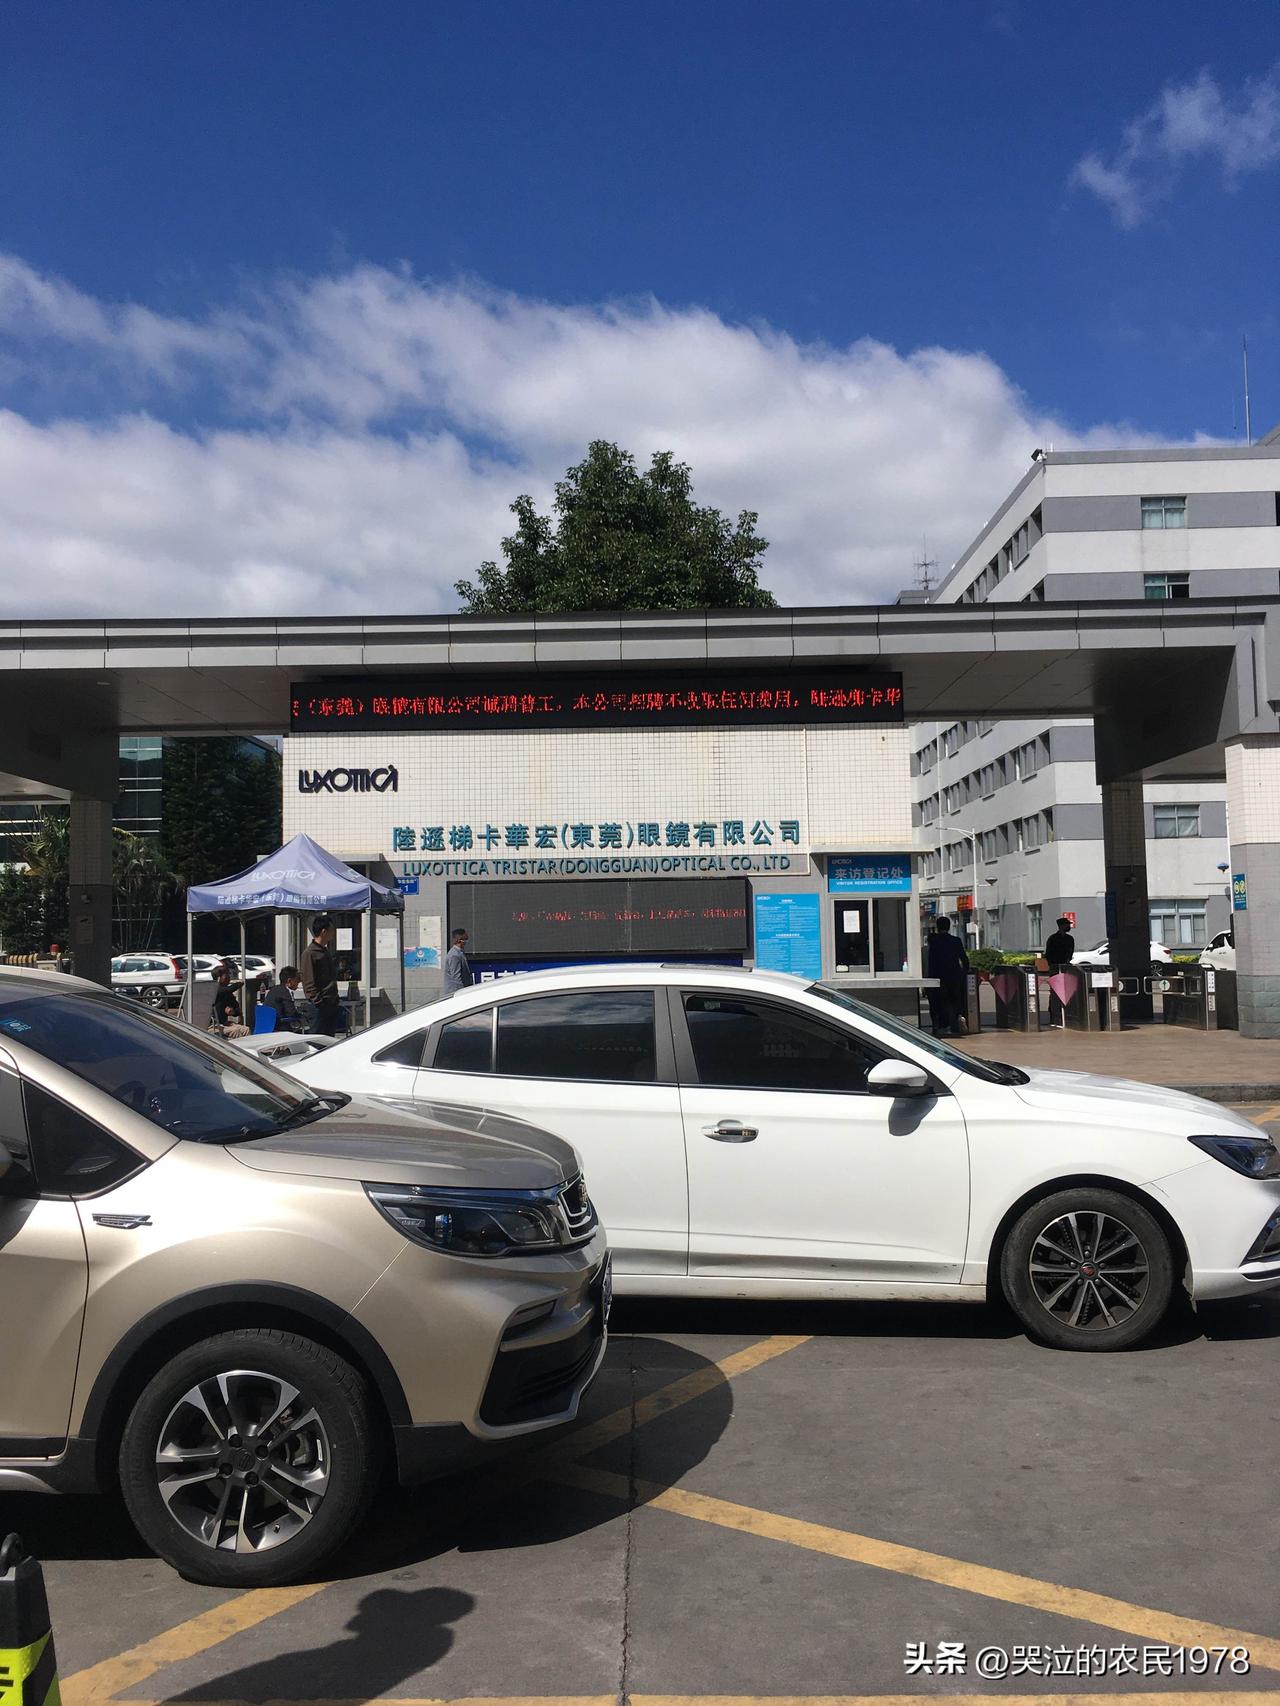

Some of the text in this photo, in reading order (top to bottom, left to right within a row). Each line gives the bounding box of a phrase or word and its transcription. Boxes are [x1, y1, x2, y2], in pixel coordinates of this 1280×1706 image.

[298, 764, 399, 793] LUXOTTICA
[402, 860, 489, 876] LUXOTTICA
[764, 855, 791, 871] LTD
[835, 867, 904, 880] 来访登记处
